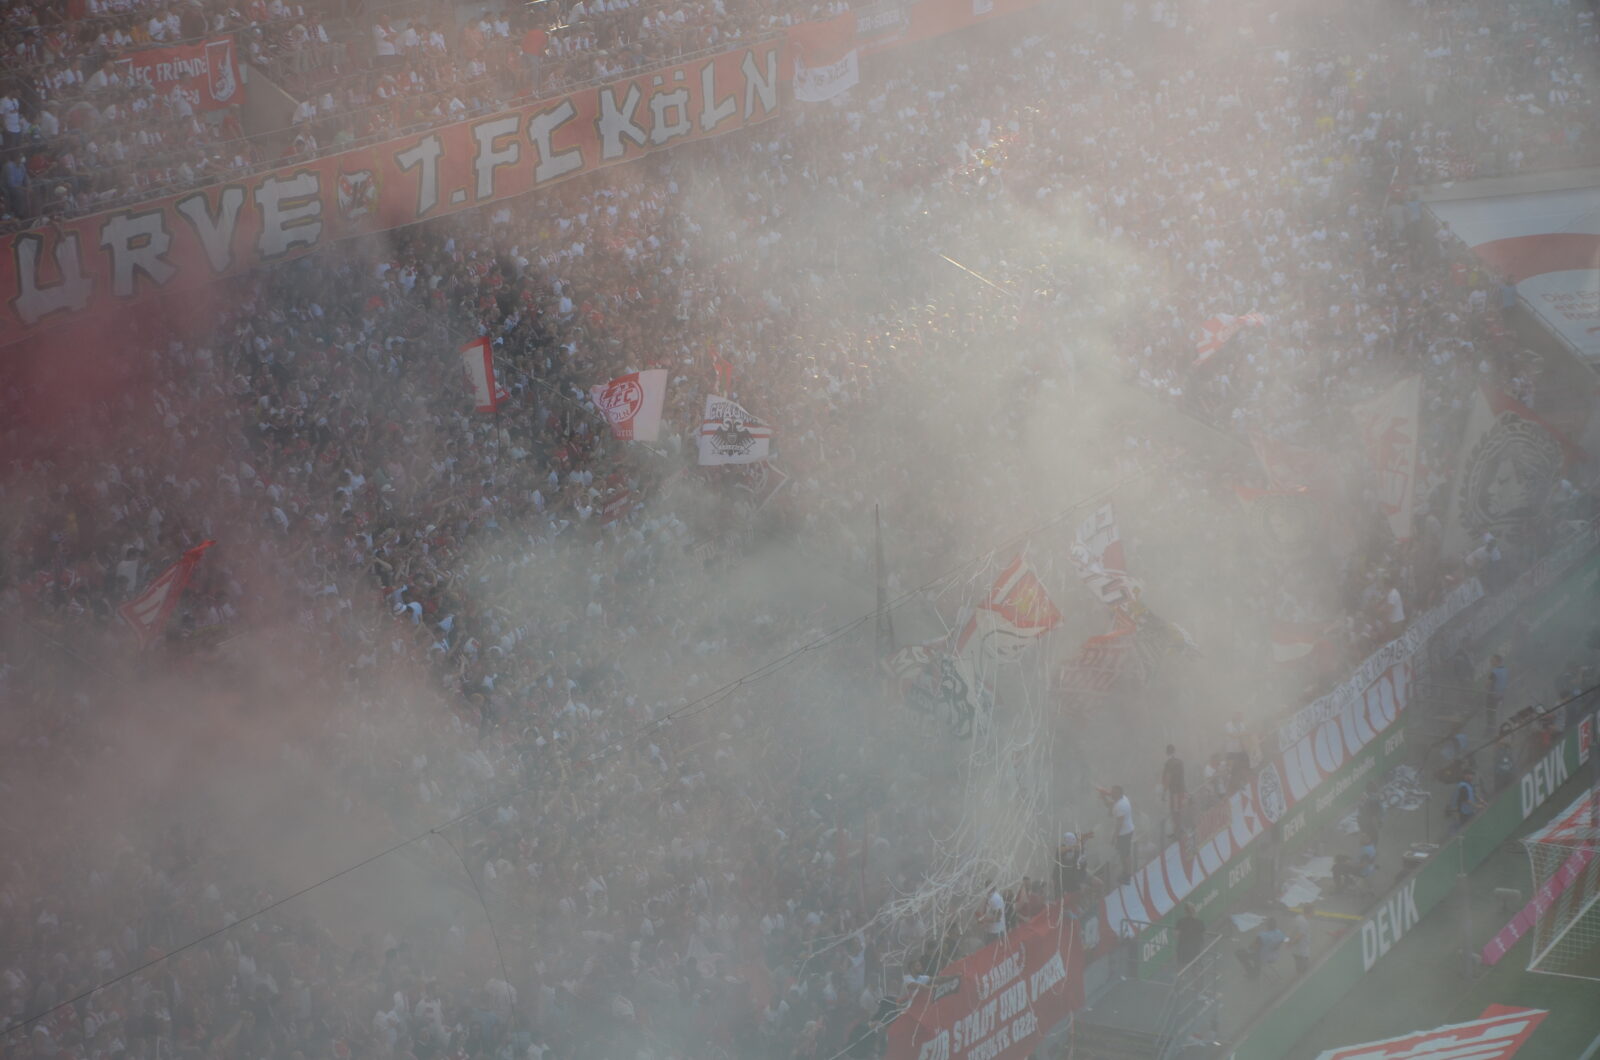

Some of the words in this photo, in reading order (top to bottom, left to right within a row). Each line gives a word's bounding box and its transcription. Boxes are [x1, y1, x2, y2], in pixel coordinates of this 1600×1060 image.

[598, 49, 778, 161] KÖLN
[1521, 738, 1569, 820] DEVK
[1361, 879, 1420, 973] DEVK
[953, 999, 998, 1054] STADT
[999, 980, 1028, 1021] UND
